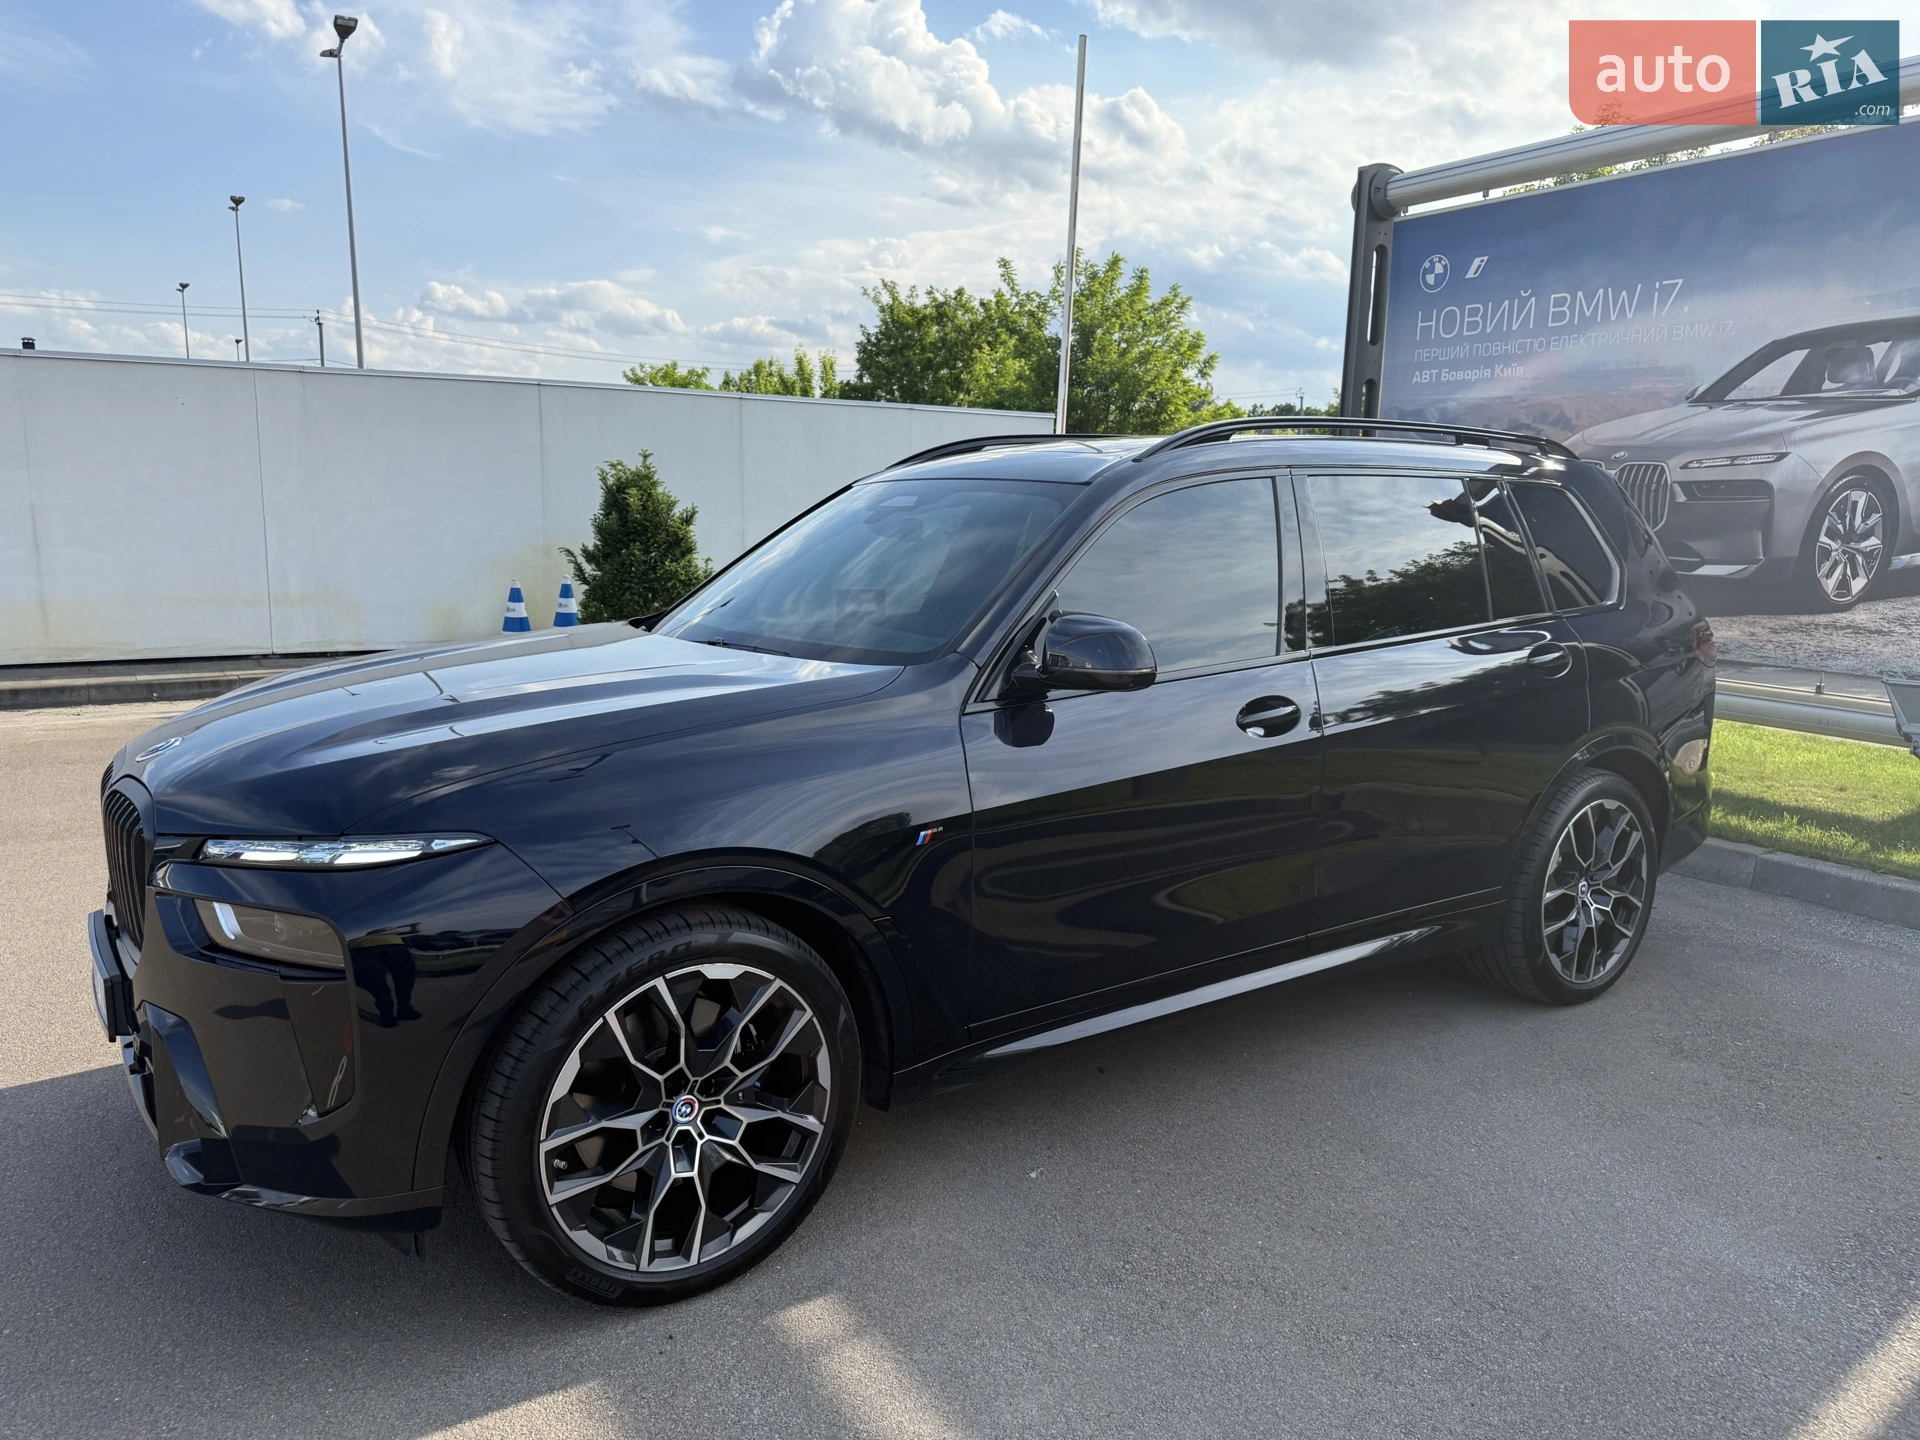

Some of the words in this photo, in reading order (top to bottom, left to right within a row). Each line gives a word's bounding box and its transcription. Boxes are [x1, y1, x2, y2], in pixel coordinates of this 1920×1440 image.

[1416, 289, 1537, 341] НОВИЙ
[1547, 283, 1642, 327] BMW
[1652, 278, 1689, 317] i7.
[1414, 342, 1470, 362] ПЕРШИЙ
[1472, 337, 1547, 358] ПОВНІСТЮ
[1549, 323, 1668, 351] ЕЛЕКТРИЧНИЙ
[1672, 323, 1716, 341] BMW
[1412, 369, 1439, 384] АВТ
[1440, 366, 1491, 382] Баварія
[1494, 363, 1525, 378] Київ
